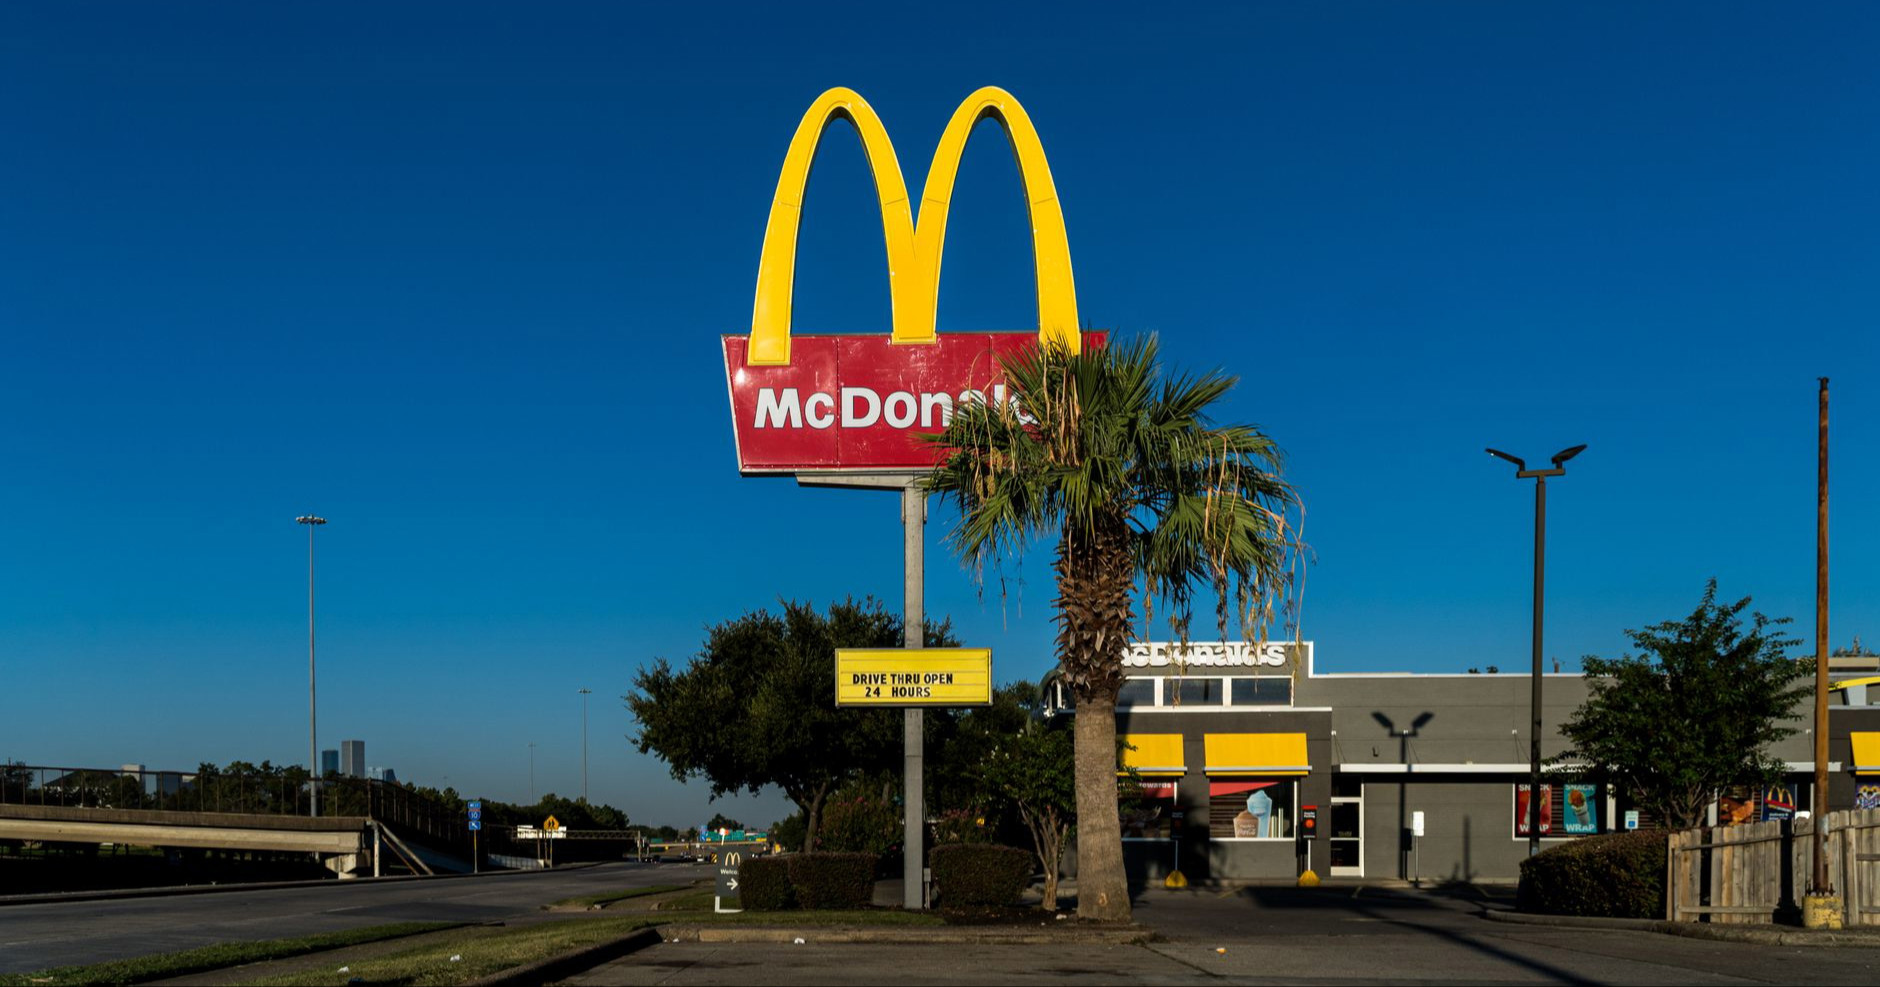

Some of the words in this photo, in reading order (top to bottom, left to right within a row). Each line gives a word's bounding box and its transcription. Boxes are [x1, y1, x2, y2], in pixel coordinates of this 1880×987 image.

[852, 673, 887, 685] DRIVE
[890, 673, 920, 685] THRU
[923, 673, 953, 685] OPEN
[865, 686, 881, 698] 24
[891, 686, 931, 698] HOURS
[1566, 824, 1595, 832] WRAP
